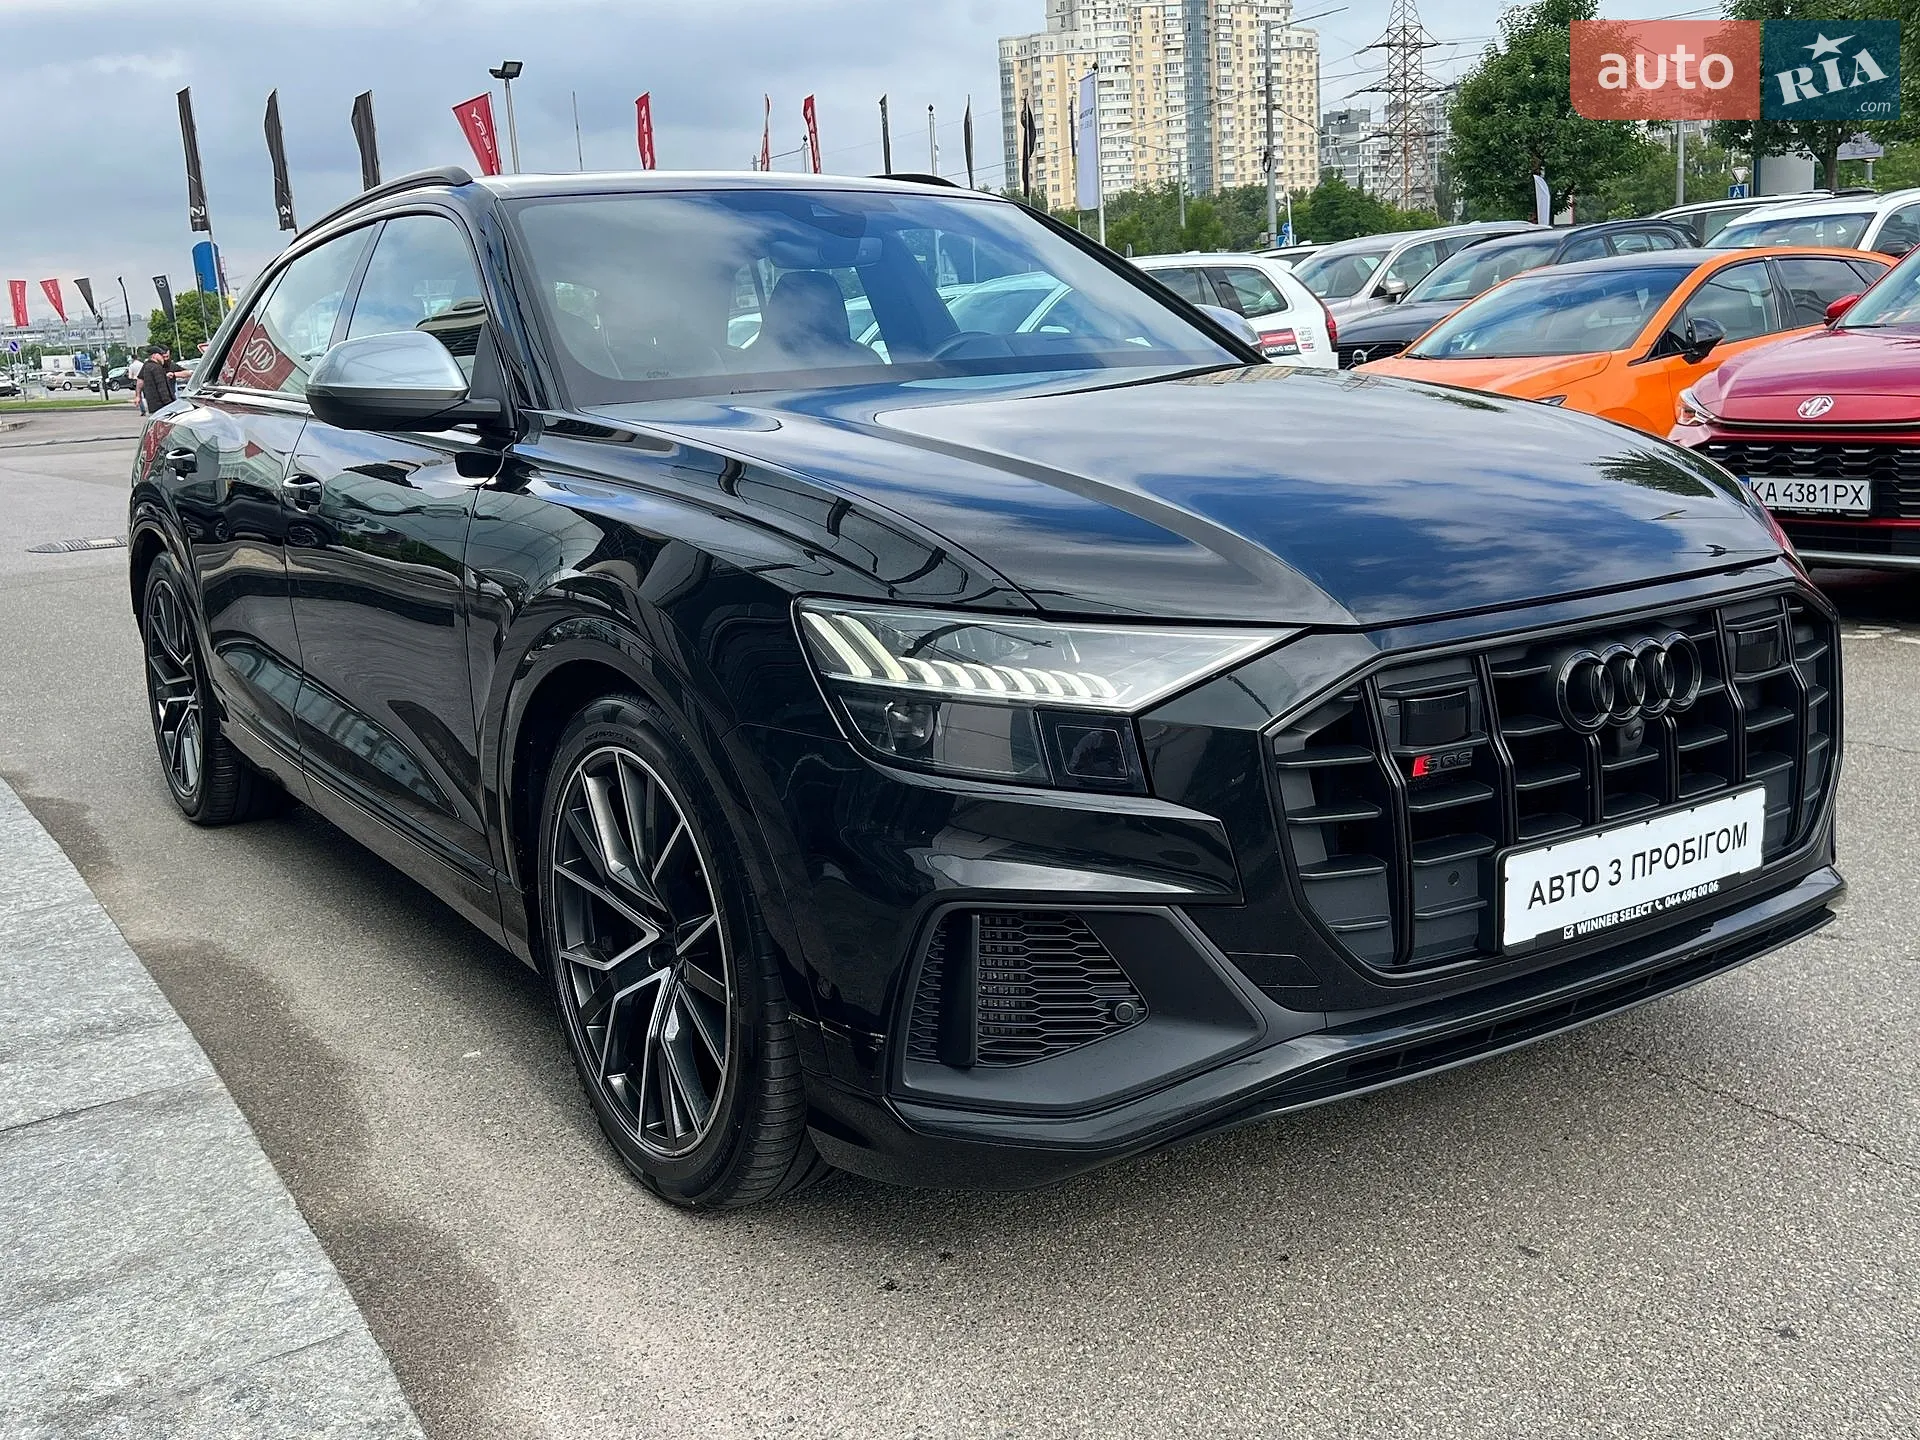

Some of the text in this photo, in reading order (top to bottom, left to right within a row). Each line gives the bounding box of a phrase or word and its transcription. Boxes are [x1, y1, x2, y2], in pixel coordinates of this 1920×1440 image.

[1799, 396, 1833, 418] MG
[1783, 482, 1829, 504] 4381
[1834, 484, 1865, 505] PX
[1527, 865, 1600, 910] АВТО
[1631, 821, 1748, 880] ПРОБІГОМ
[1576, 911, 1619, 935] WINNER
[1619, 902, 1654, 921] SELECT
[1665, 893, 1681, 908] 044
[1681, 888, 1697, 902] 496
